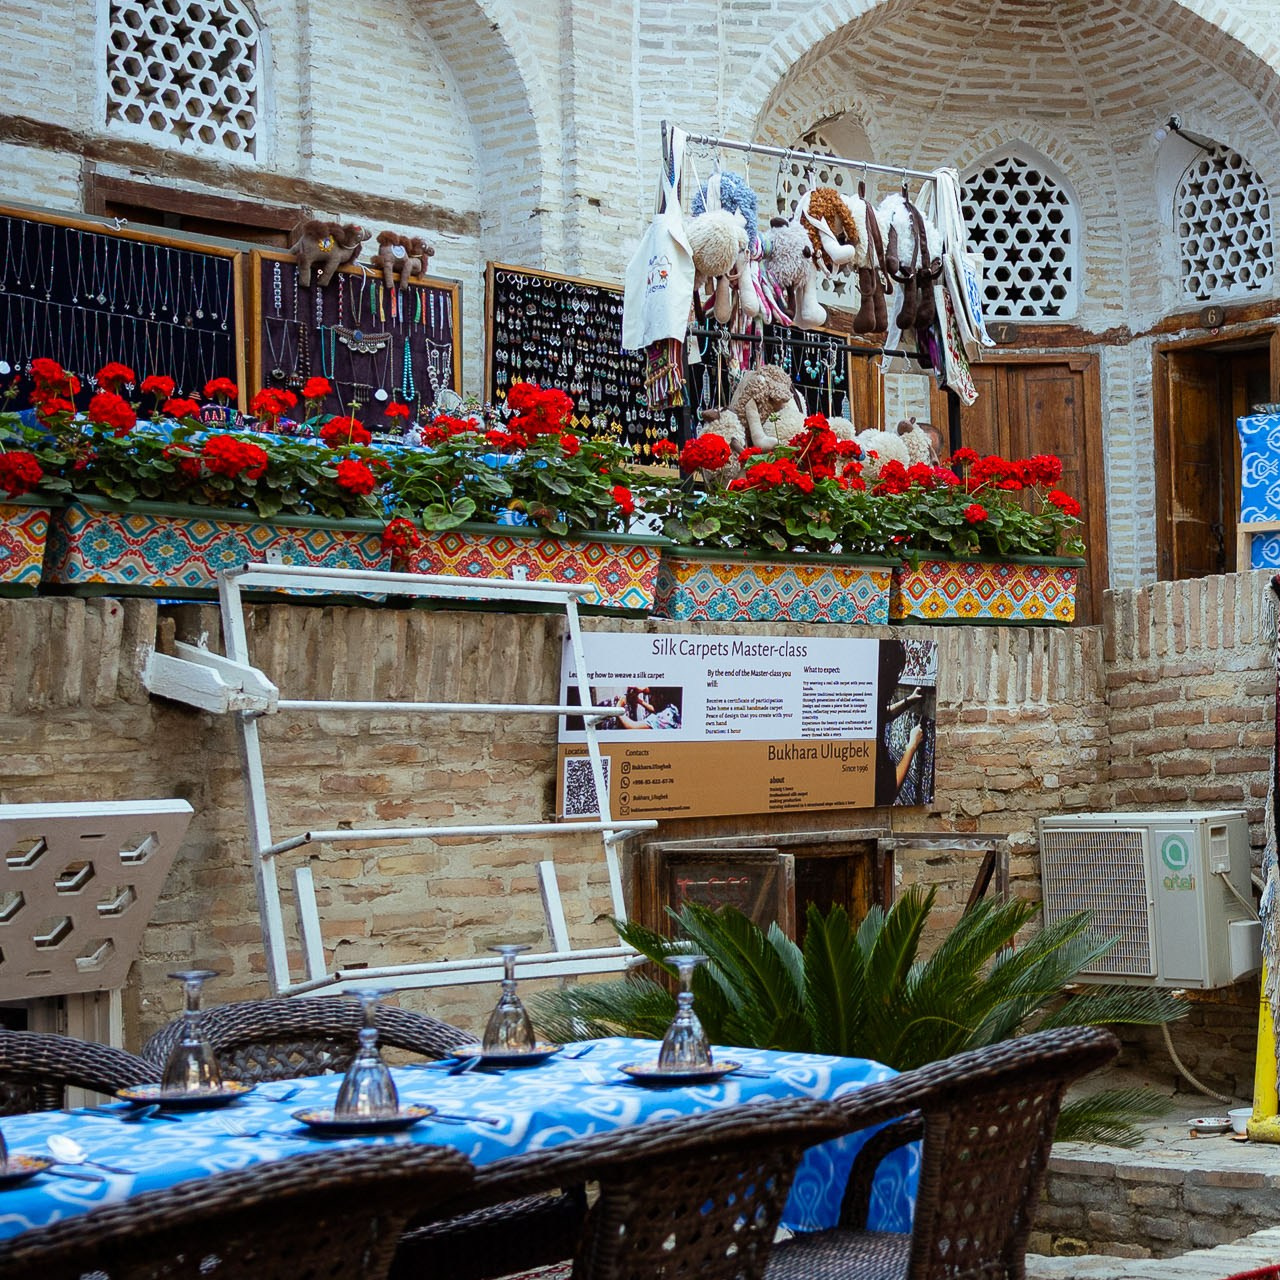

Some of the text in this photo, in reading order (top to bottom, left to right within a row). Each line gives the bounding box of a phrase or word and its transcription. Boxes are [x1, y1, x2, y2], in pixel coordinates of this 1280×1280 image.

[1208, 309, 1216, 324] 6
[998, 325, 1008, 340] 7
[652, 638, 808, 660] Silk Carpets Master-class
[568, 671, 594, 680] Leang
[708, 670, 714, 678] By
[768, 742, 870, 762] Bukhara Ulugbek
[842, 764, 869, 773] Since 1996
